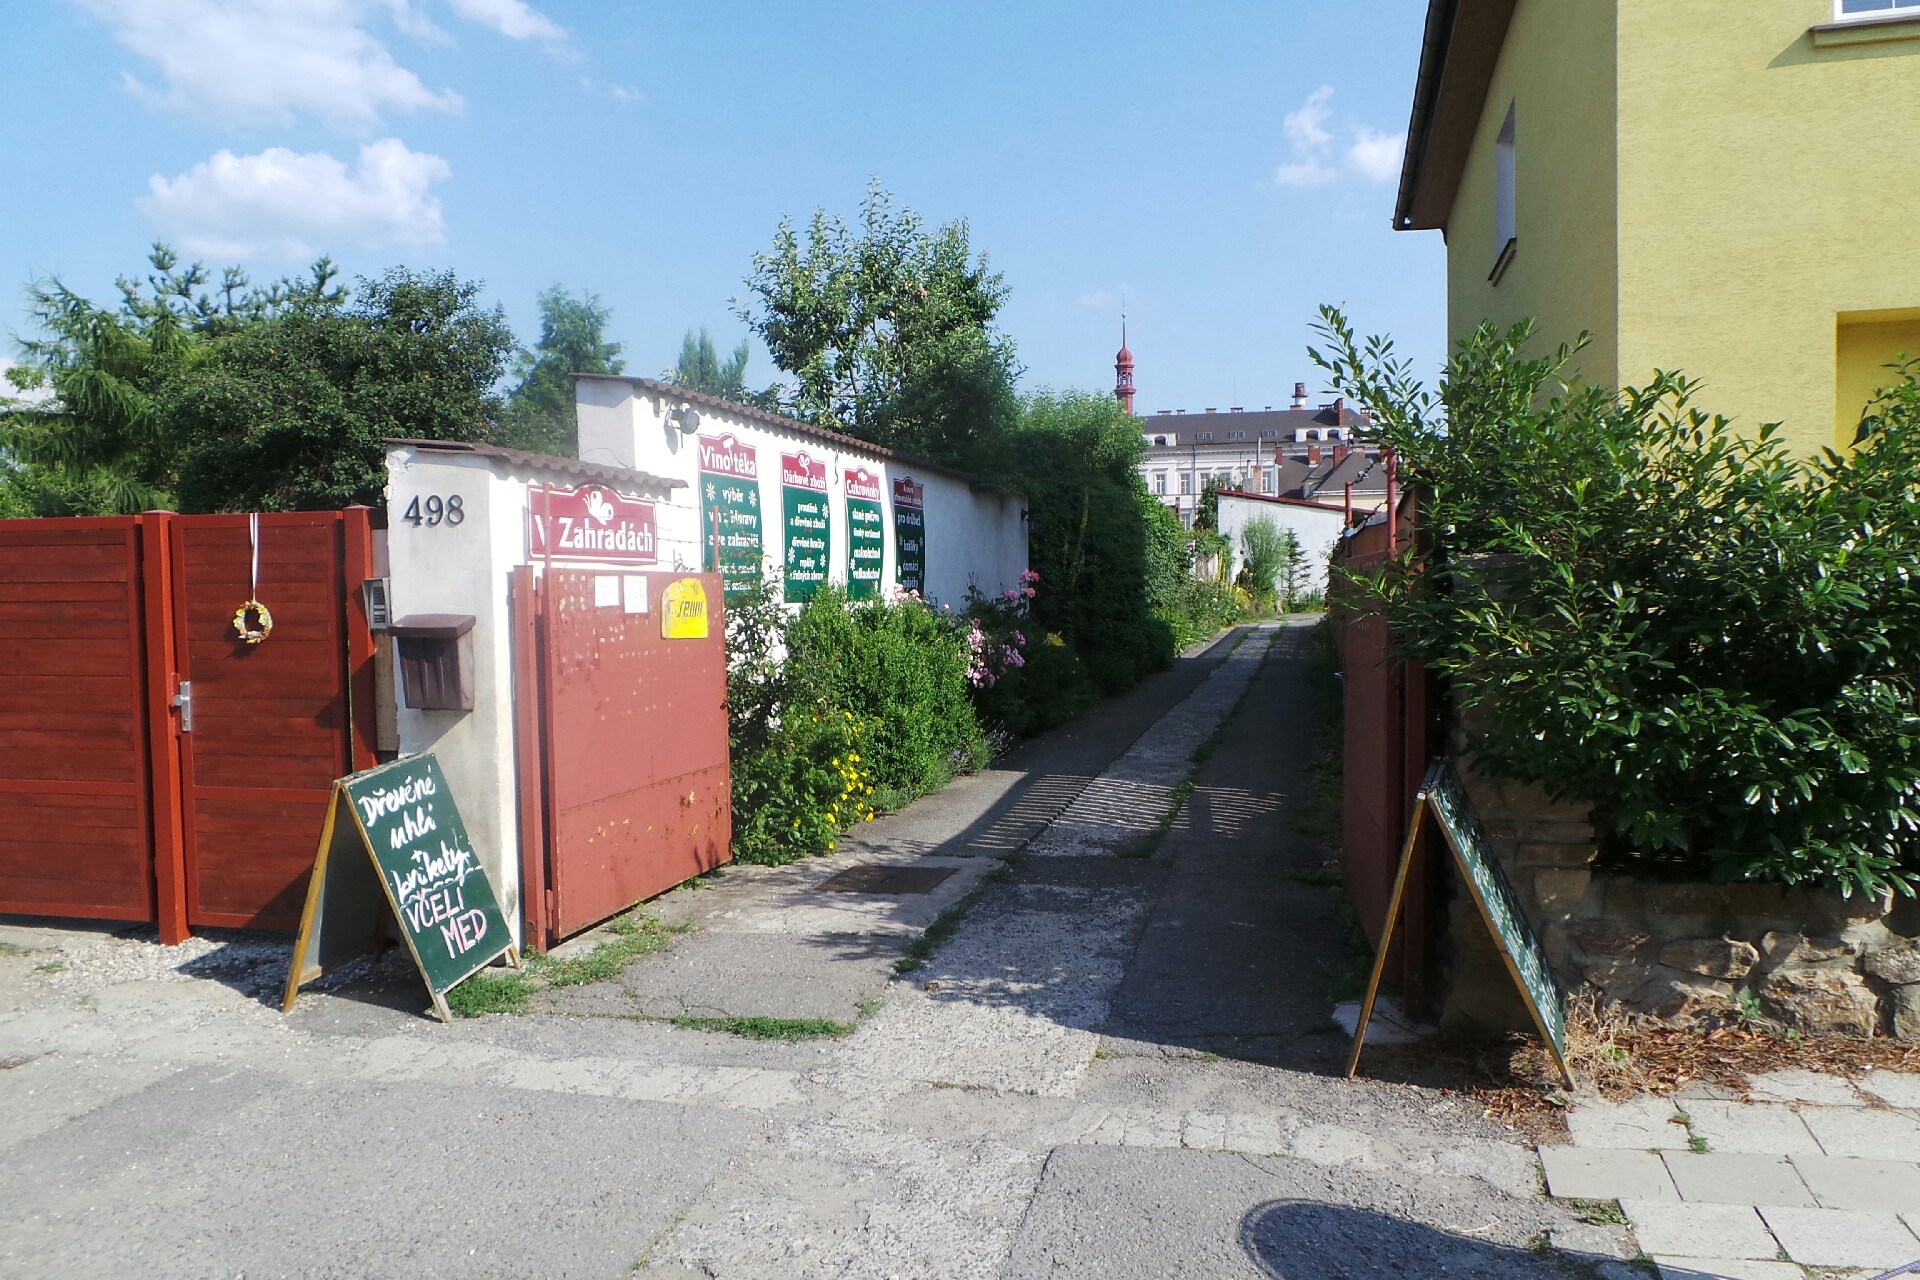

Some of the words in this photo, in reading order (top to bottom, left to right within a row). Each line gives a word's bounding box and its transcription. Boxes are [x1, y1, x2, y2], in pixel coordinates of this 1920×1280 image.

[700, 444, 756, 476] Vinotéka
[783, 469, 809, 486] Dárkové
[810, 474, 826, 490] zboží
[722, 486, 744, 504] výběr
[847, 479, 879, 500] Cukrovinky
[404, 494, 464, 525] 498
[708, 511, 722, 523] vn
[865, 510, 880, 524] pečivo
[790, 517, 795, 526] a
[897, 513, 905, 525] pro
[558, 517, 653, 552] Zahradách
[810, 537, 825, 551] hračky
[852, 567, 881, 580] velkoobchod
[902, 560, 919, 571] domácí
[391, 840, 471, 905] brikety
[440, 908, 488, 959] MED
